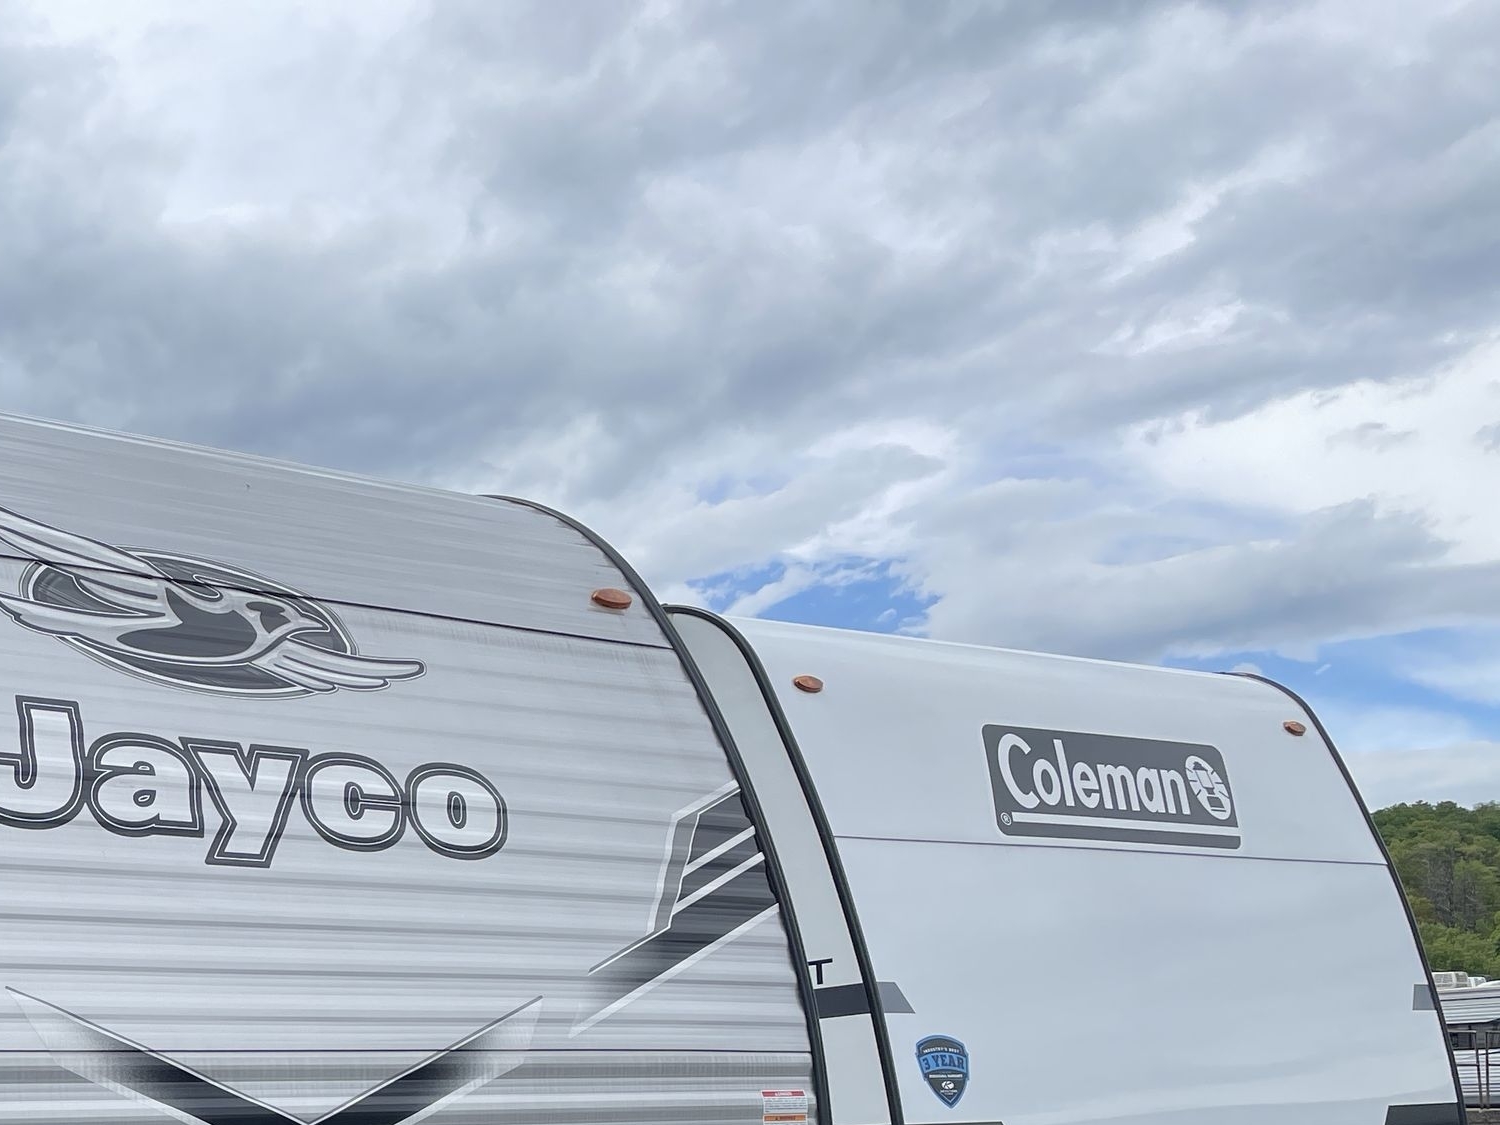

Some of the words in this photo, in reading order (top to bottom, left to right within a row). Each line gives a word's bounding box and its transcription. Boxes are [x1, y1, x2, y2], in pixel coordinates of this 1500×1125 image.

[997, 733, 1191, 816] Coleman
[922, 1056, 931, 1071] 3
[931, 1054, 965, 1070] YEAR
